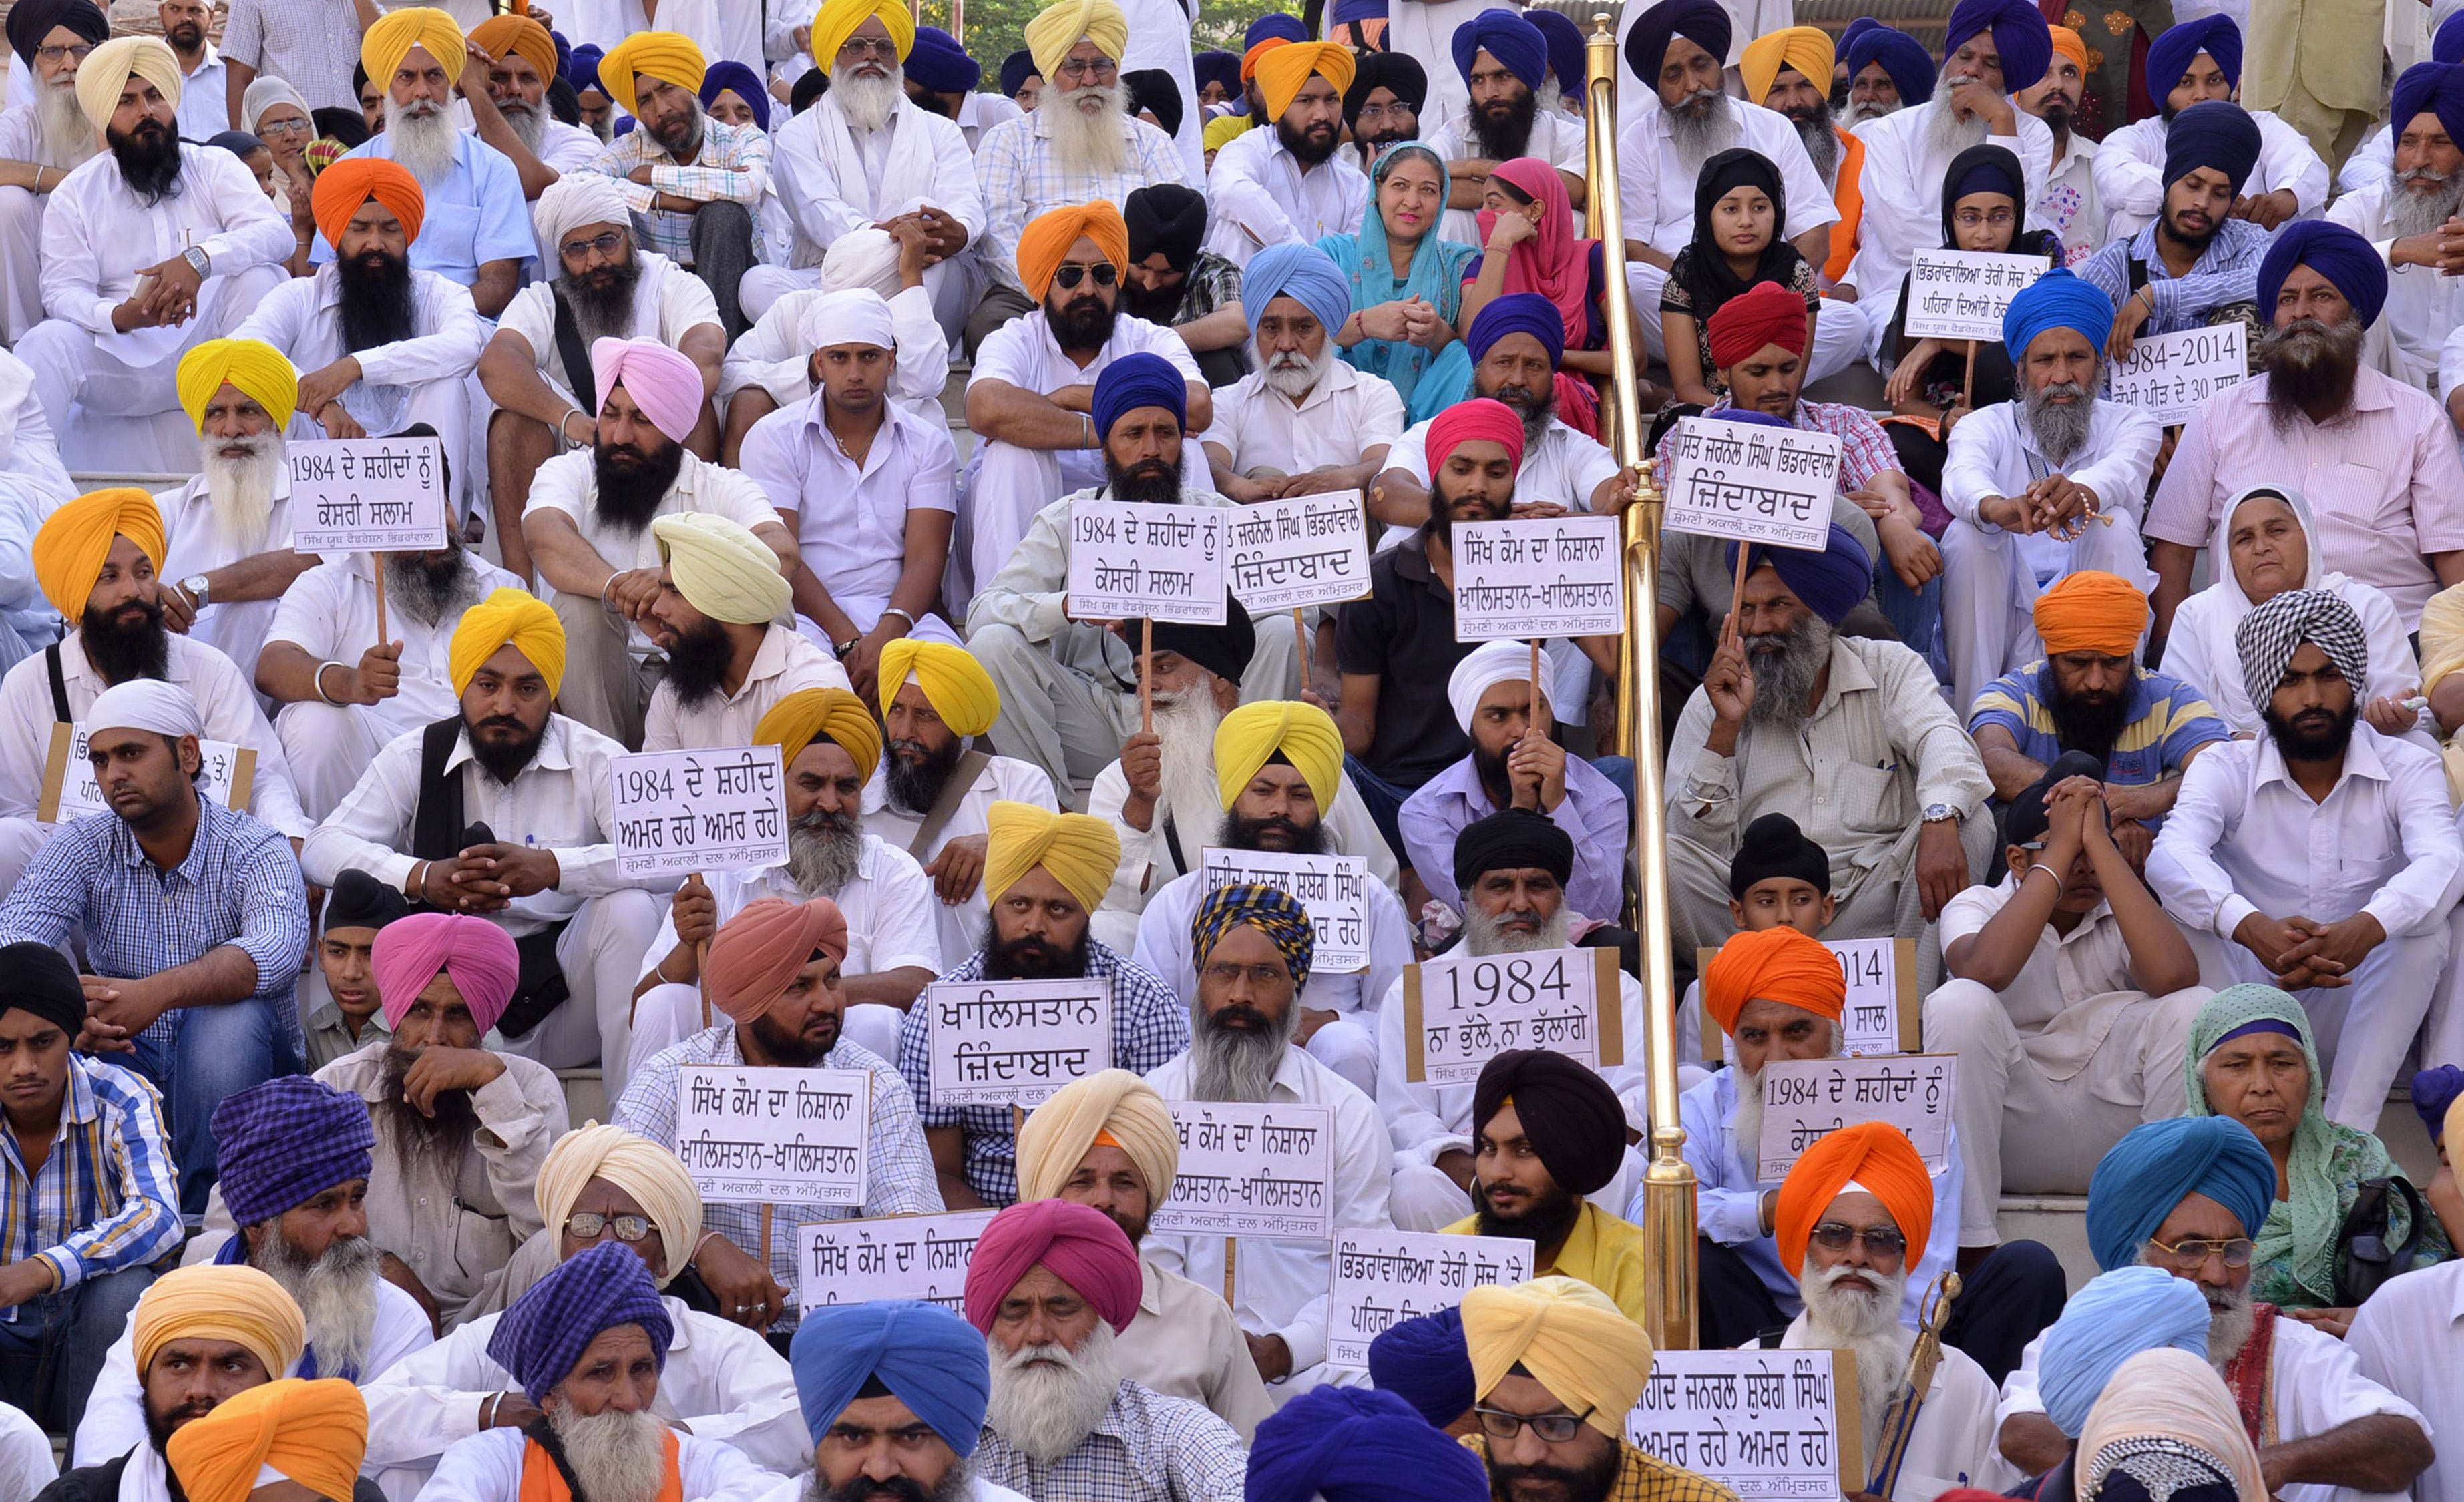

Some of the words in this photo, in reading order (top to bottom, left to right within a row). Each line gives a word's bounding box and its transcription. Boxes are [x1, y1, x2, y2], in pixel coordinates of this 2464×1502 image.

[1985, 263, 2004, 286] ਤੇਰੀ
[2007, 263, 2025, 288] ਸੋਚ
[1923, 291, 1953, 314] ਪਹਿਰਾ
[1957, 293, 1991, 318] ਦਿਆਂਗੇ
[2174, 375, 2185, 402] ਦੇ
[2192, 378, 2208, 401] 30
[293, 455, 335, 481] 1984
[341, 448, 355, 479] ਦੇ
[363, 447, 410, 479] ਸ਼ਹੀਦਾਂ
[417, 445, 430, 489] ਨੂੰ
[1681, 425, 1702, 459] ਸੰਤ
[1705, 428, 1743, 466] ਜਰਨੈਲ
[1747, 433, 1774, 470] ਸਿੰਘ
[1777, 437, 1836, 479] ਭਿੰਡਰਾਂਵਾਲੇ
[317, 493, 362, 527] ਕੇਸਰੀ
[369, 502, 413, 525] ਸਲਾਮ
[1689, 467, 1816, 521] ਜ਼ਿੰਦਾਬਾਦ
[1074, 516, 1116, 543] 1984
[1124, 511, 1139, 544] ਦੇ
[1146, 513, 1196, 547] ਸ਼ਹੀਦਾਂ
[1203, 515, 1217, 561] ਨੂੰ
[1237, 511, 1273, 547] ਜਰਨੈਲ
[1277, 507, 1300, 541] ਸਿੰਘ
[1304, 499, 1359, 537] ਭਿੰਡਰਾਂਵਾਲੇ
[1748, 523, 1766, 534] ਦਲ
[1465, 531, 1494, 565] ਸਿੱਖ
[1500, 528, 1524, 563] ਕੌਮ
[1531, 538, 1549, 563] ਦਾ
[1555, 528, 1605, 562] ਨਿਸ਼ਾਨਾ
[1095, 557, 1141, 593] ਕੇਸਰੀ
[1149, 570, 1194, 596] ਸਲਾਮ
[1231, 549, 1351, 590] ਜ਼ਿੰਦਾਬਾਦ
[1297, 590, 1314, 599] ਦਲ
[1541, 620, 1558, 630] ਦਲ
[618, 768, 674, 804] 1984
[684, 757, 704, 798] ਦੇ
[714, 752, 775, 795] ਸ਼ਹੀਦ
[620, 819, 663, 849] ਅਮਰ
[670, 804, 695, 846] ਰਹੇ
[704, 812, 745, 842] ਅਮਰ
[753, 797, 778, 838] ਰਹੇ
[706, 852, 724, 862] ਦਲ
[1333, 862, 1363, 902] ਸਿੰਘ
[1337, 907, 1362, 945] ਰਹੇ
[1446, 956, 1571, 1010] 1984
[1854, 1005, 1886, 1032] ਸਾਲ
[1428, 1027, 1450, 1053] ਨਾ
[954, 1041, 1090, 1082] ਜ਼ਿੰਦਾਬਾਦ
[692, 1075, 725, 1115] ਸਿੱਖ
[733, 1075, 761, 1116] ਕੌਮ
[768, 1090, 788, 1117] ਦਾ
[796, 1080, 852, 1120] ਨਿਸ਼ਾਨਾ
[981, 1088, 1020, 1101] ਅਕਾਲੀ
[1026, 1089, 1045, 1099] ਦਲ
[1768, 1078, 1818, 1105] 1984
[1829, 1069, 1846, 1103] ਦੇ
[1855, 1067, 1917, 1103] ਸ਼ਹੀਦਾਂ
[1926, 1066, 1942, 1113] ਨੂੰ
[1199, 1109, 1226, 1151] ਕੌਮ
[1234, 1124, 1254, 1152] ਦਾ
[1261, 1115, 1317, 1155] ਨਿਸ਼ਾਨਾ
[723, 1182, 764, 1194] ਅਕਾਲੀ
[769, 1184, 790, 1195] ਦਲ
[1191, 1215, 1233, 1227] ਅਕਾਲੀ
[1237, 1218, 1257, 1228] ਦਲ
[813, 1234, 849, 1277] ਸਿੱਖ
[857, 1230, 887, 1274] ਕੌਮ
[895, 1242, 916, 1272] ਦਾ
[1340, 1242, 1434, 1284] ਭਿੰਡਰਾਂਵਾਲਿਆ
[1440, 1250, 1468, 1288] ਤੇਰੀ
[1351, 1296, 1394, 1333] ਪਹਿਰਾ
[1684, 1374, 1737, 1410] ਜਨਰਲ
[1744, 1359, 1784, 1420] ਸ਼ੁਬੇਗ
[1793, 1359, 1828, 1410] ਸਿੰਘ
[1635, 1431, 1689, 1467] ਅਮਰ
[1697, 1417, 1728, 1467] ਰਹੇ
[1738, 1431, 1790, 1467] ਅਮਰ
[1798, 1417, 1828, 1467] ਰਹੇ
[1739, 1480, 1762, 1492] ਦਲ
